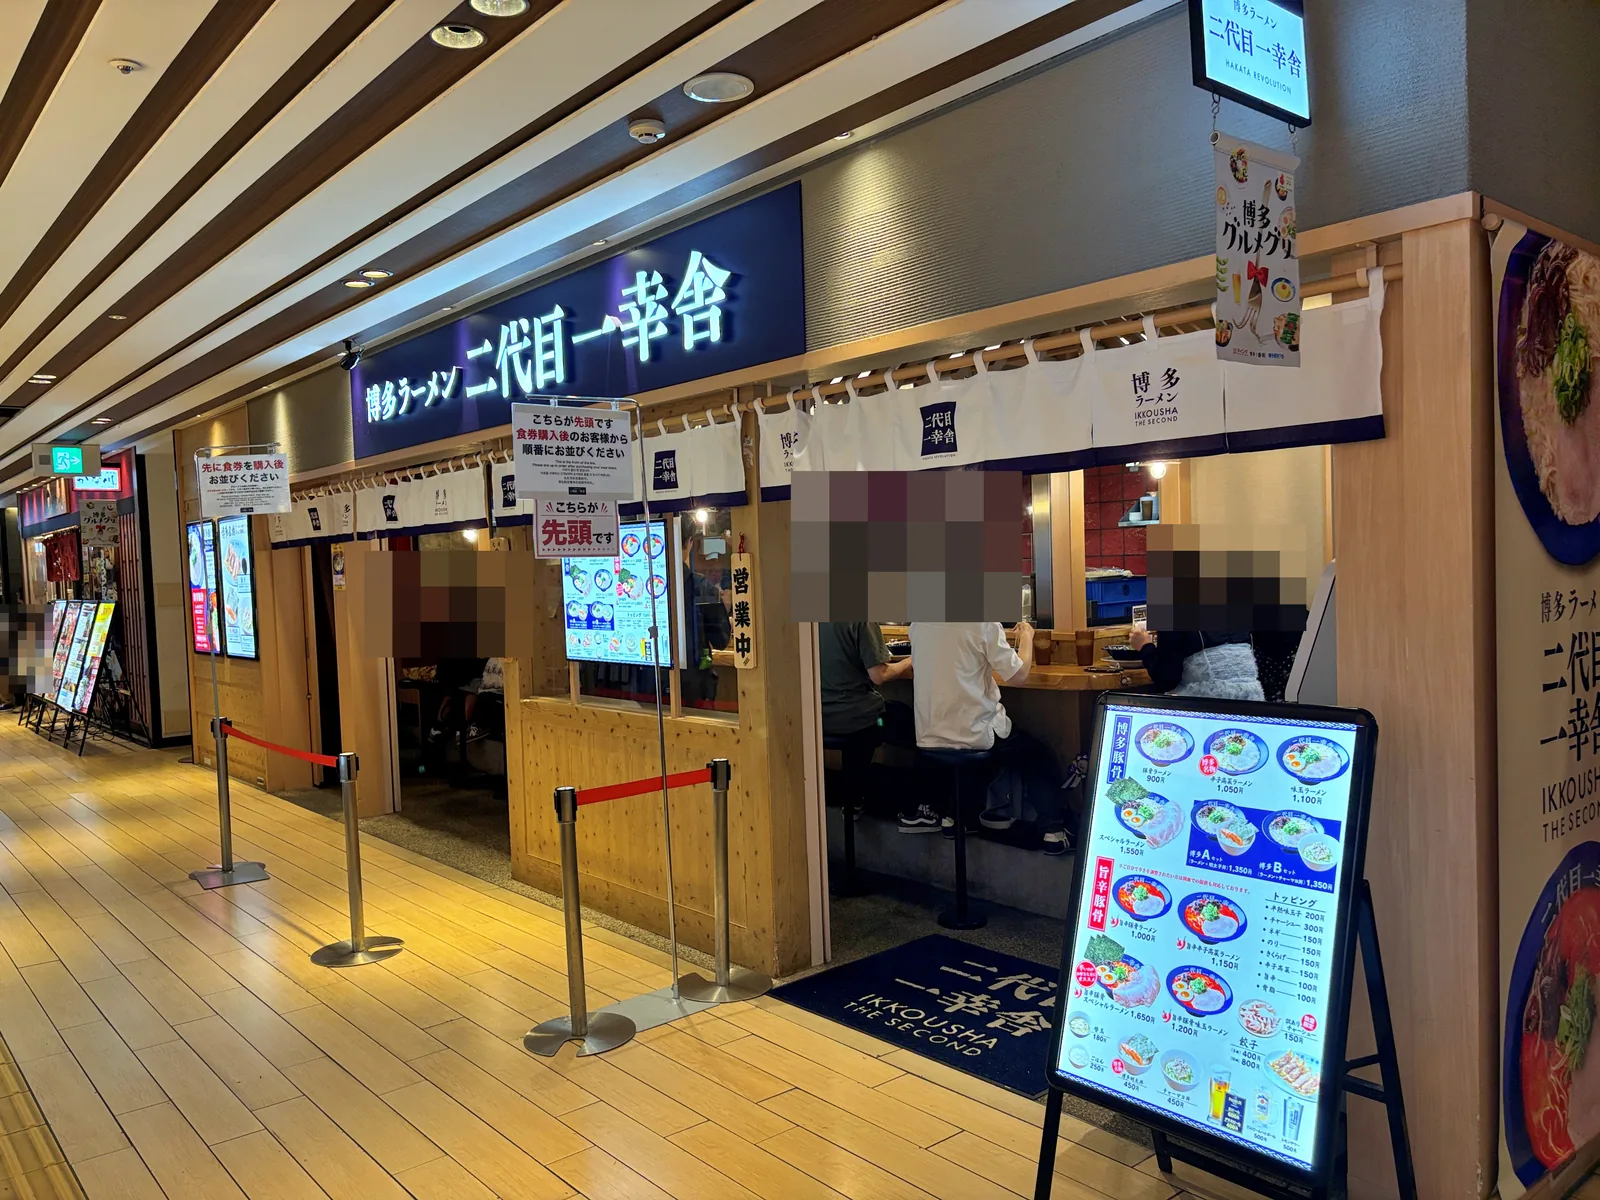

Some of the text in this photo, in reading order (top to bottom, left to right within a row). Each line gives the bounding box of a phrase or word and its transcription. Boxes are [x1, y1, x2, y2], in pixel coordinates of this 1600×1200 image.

[1209, 15, 1301, 78] 二代目一幸舎
[1225, 59, 1292, 94] HAKATA REVOLUTION
[1242, 199, 1271, 229] 博多
[1222, 217, 1292, 260] グルメグリ
[365, 250, 731, 423] 博多ラーメン 二代目一幸舎
[1131, 368, 1180, 394] 博多
[1136, 392, 1178, 408] ラーメン
[925, 411, 952, 428] 二代目
[1134, 407, 1178, 420] IKKOUSHA
[1148, 416, 1178, 425] SECOND
[533, 414, 613, 429] こちらが先頭です
[516, 428, 628, 445] 食券購入後のお客様から
[924, 428, 954, 444] 一幸舎
[522, 443, 625, 458] 順番にお並びください
[202, 460, 284, 473] 先に食券を購入後
[209, 473, 279, 484] お並びください
[556, 502, 599, 514] こちらが
[541, 519, 614, 546] 先頭です
[733, 567, 751, 659] 営業中
[1111, 722, 1128, 778] 博多豚骨
[1146, 775, 1165, 783] 900円
[1217, 785, 1244, 794] 1,050円
[1290, 786, 1327, 797] 味玉ラーメン
[1292, 794, 1323, 805] 1,100円
[1543, 814, 1565, 842] THE
[1099, 834, 1146, 848] スペシャルラーメン
[1120, 846, 1144, 857] 1,550円
[1229, 864, 1253, 875] 1,350円
[1306, 879, 1333, 891] 1,350円
[1092, 865, 1109, 924] 旨辛豚骨
[1274, 892, 1317, 907] トッピング
[1305, 912, 1325, 922] 200円
[1303, 923, 1324, 933] 300円
[1131, 930, 1156, 942] 1,000円
[1269, 928, 1322, 945] ネギ 150円
[1267, 939, 1321, 957] のり 150円
[1211, 957, 1239, 970] 1,150円
[1266, 950, 1320, 969] きくらげ 150円
[1299, 969, 1319, 980] 150円
[940, 960, 1056, 1006] 二代
[1298, 981, 1317, 992] 100円
[1297, 993, 1316, 1004] 100円
[1083, 996, 1155, 1024] スペシャルラーメン 1,650円
[843, 1002, 982, 1056] THE SECOND
[858, 994, 998, 1049] IKKOUSHA
[1171, 1022, 1198, 1037] 1,200円
[1240, 1036, 1258, 1049] 餃子
[1284, 1033, 1303, 1044] 150円
[1242, 1051, 1261, 1062] 400円
[1241, 1059, 1260, 1071] 800円
